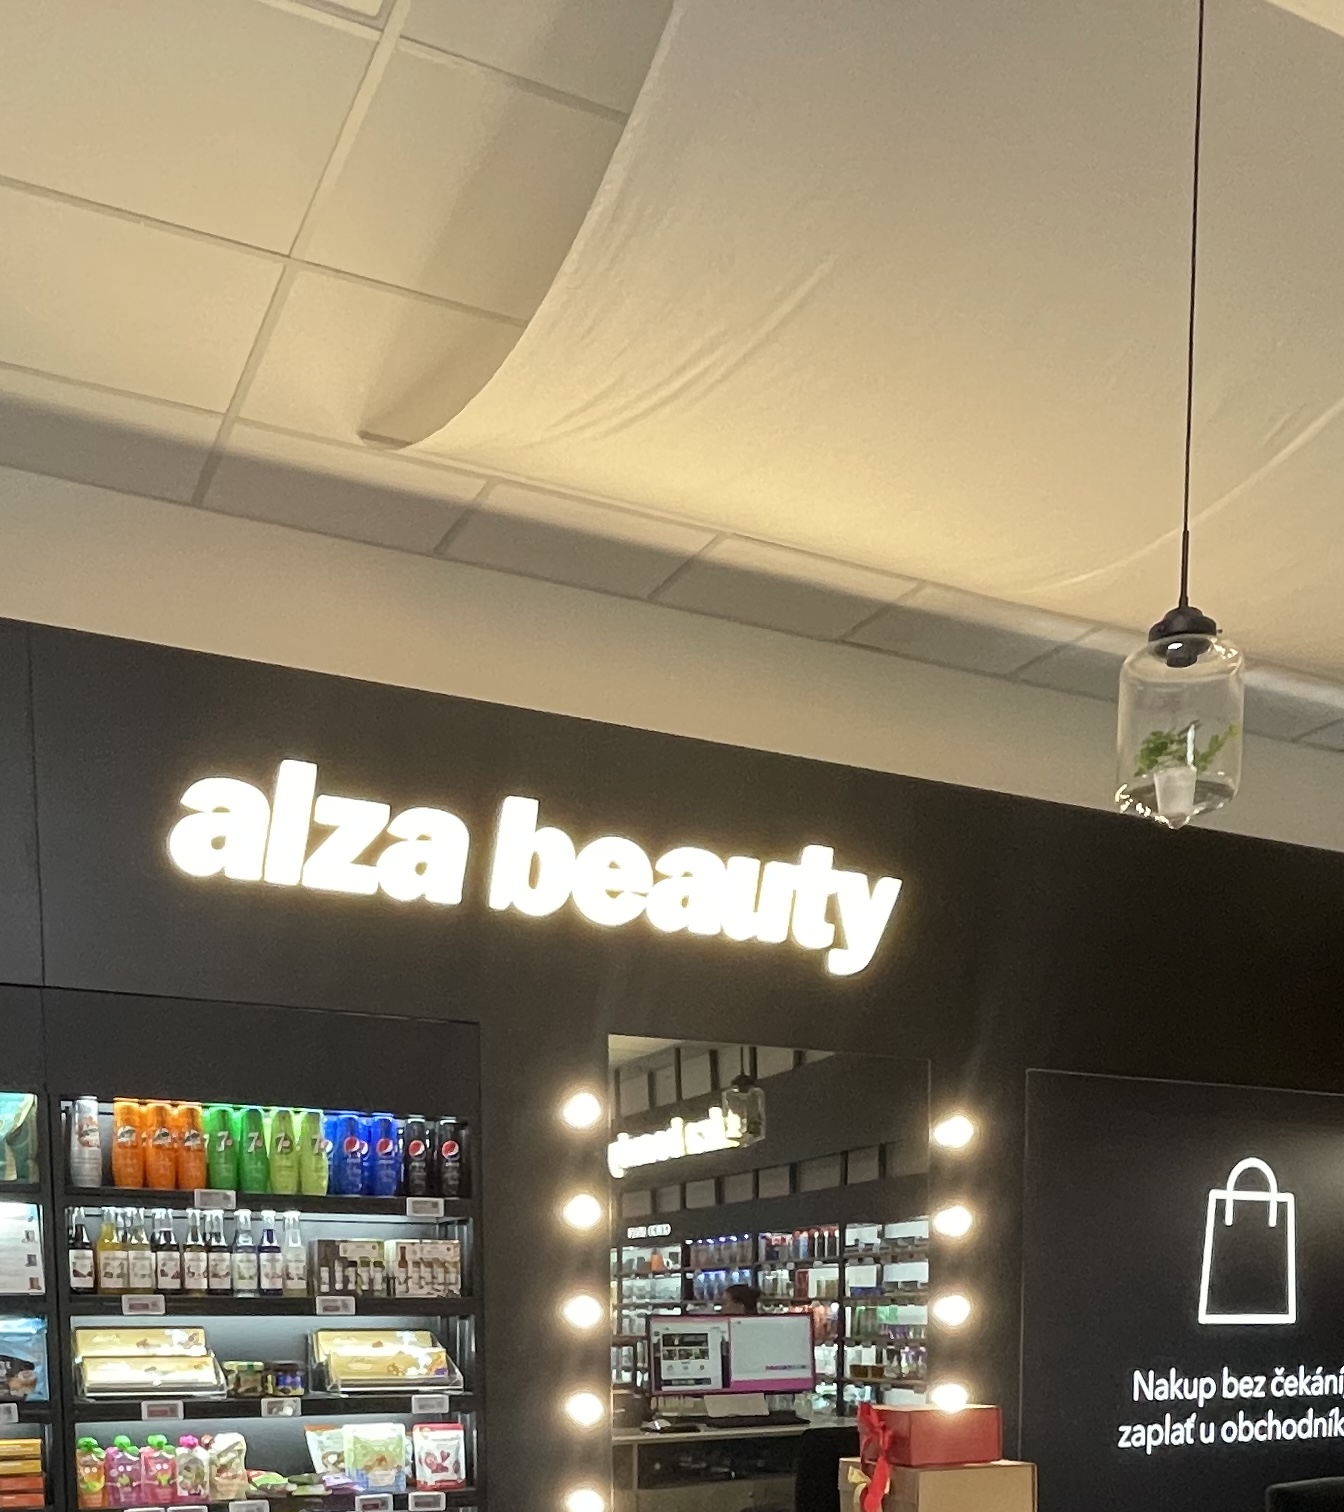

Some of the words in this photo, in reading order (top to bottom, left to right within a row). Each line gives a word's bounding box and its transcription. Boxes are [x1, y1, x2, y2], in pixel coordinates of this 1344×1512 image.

[167, 758, 468, 904] alza
[489, 795, 902, 977] beauty
[1132, 1367, 1217, 1408] Nakup
[1222, 1366, 1266, 1399] bez
[1117, 1412, 1197, 1455] zaplať
[1199, 1424, 1215, 1444] u
